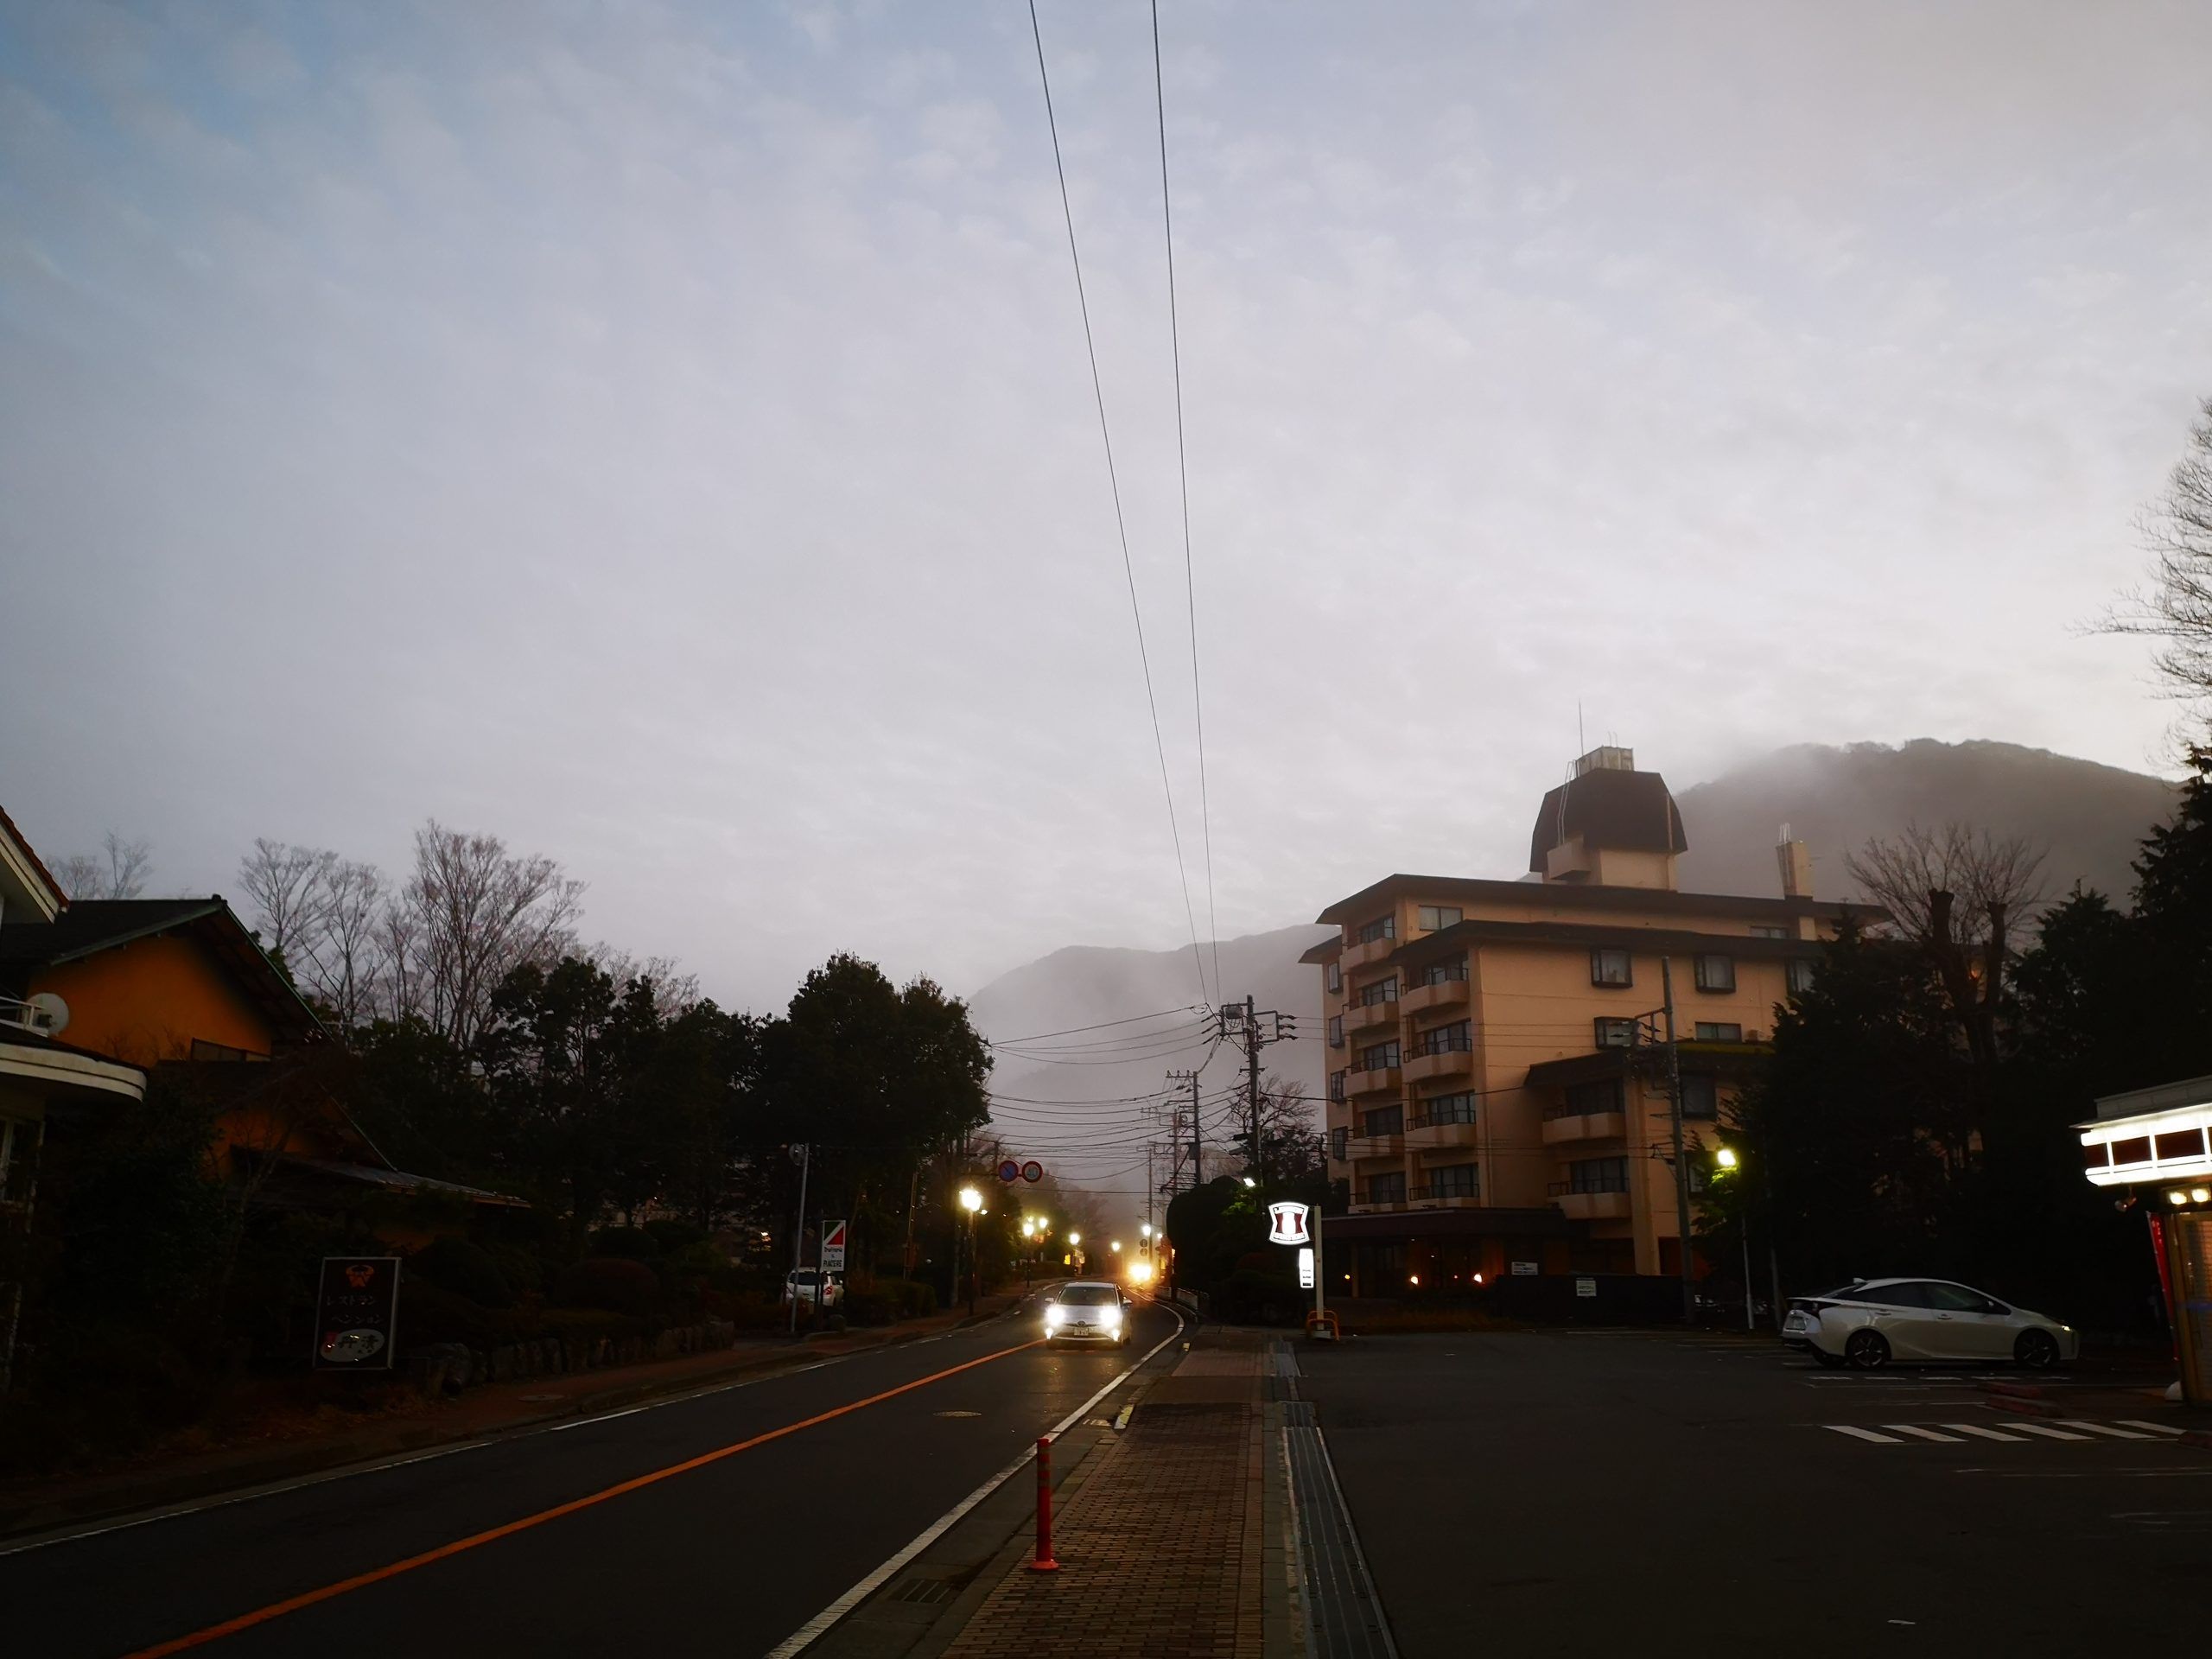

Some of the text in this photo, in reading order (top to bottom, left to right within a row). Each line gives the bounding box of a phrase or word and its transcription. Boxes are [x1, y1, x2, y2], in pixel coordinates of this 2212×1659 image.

[327, 1294, 378, 1306] レストラン
